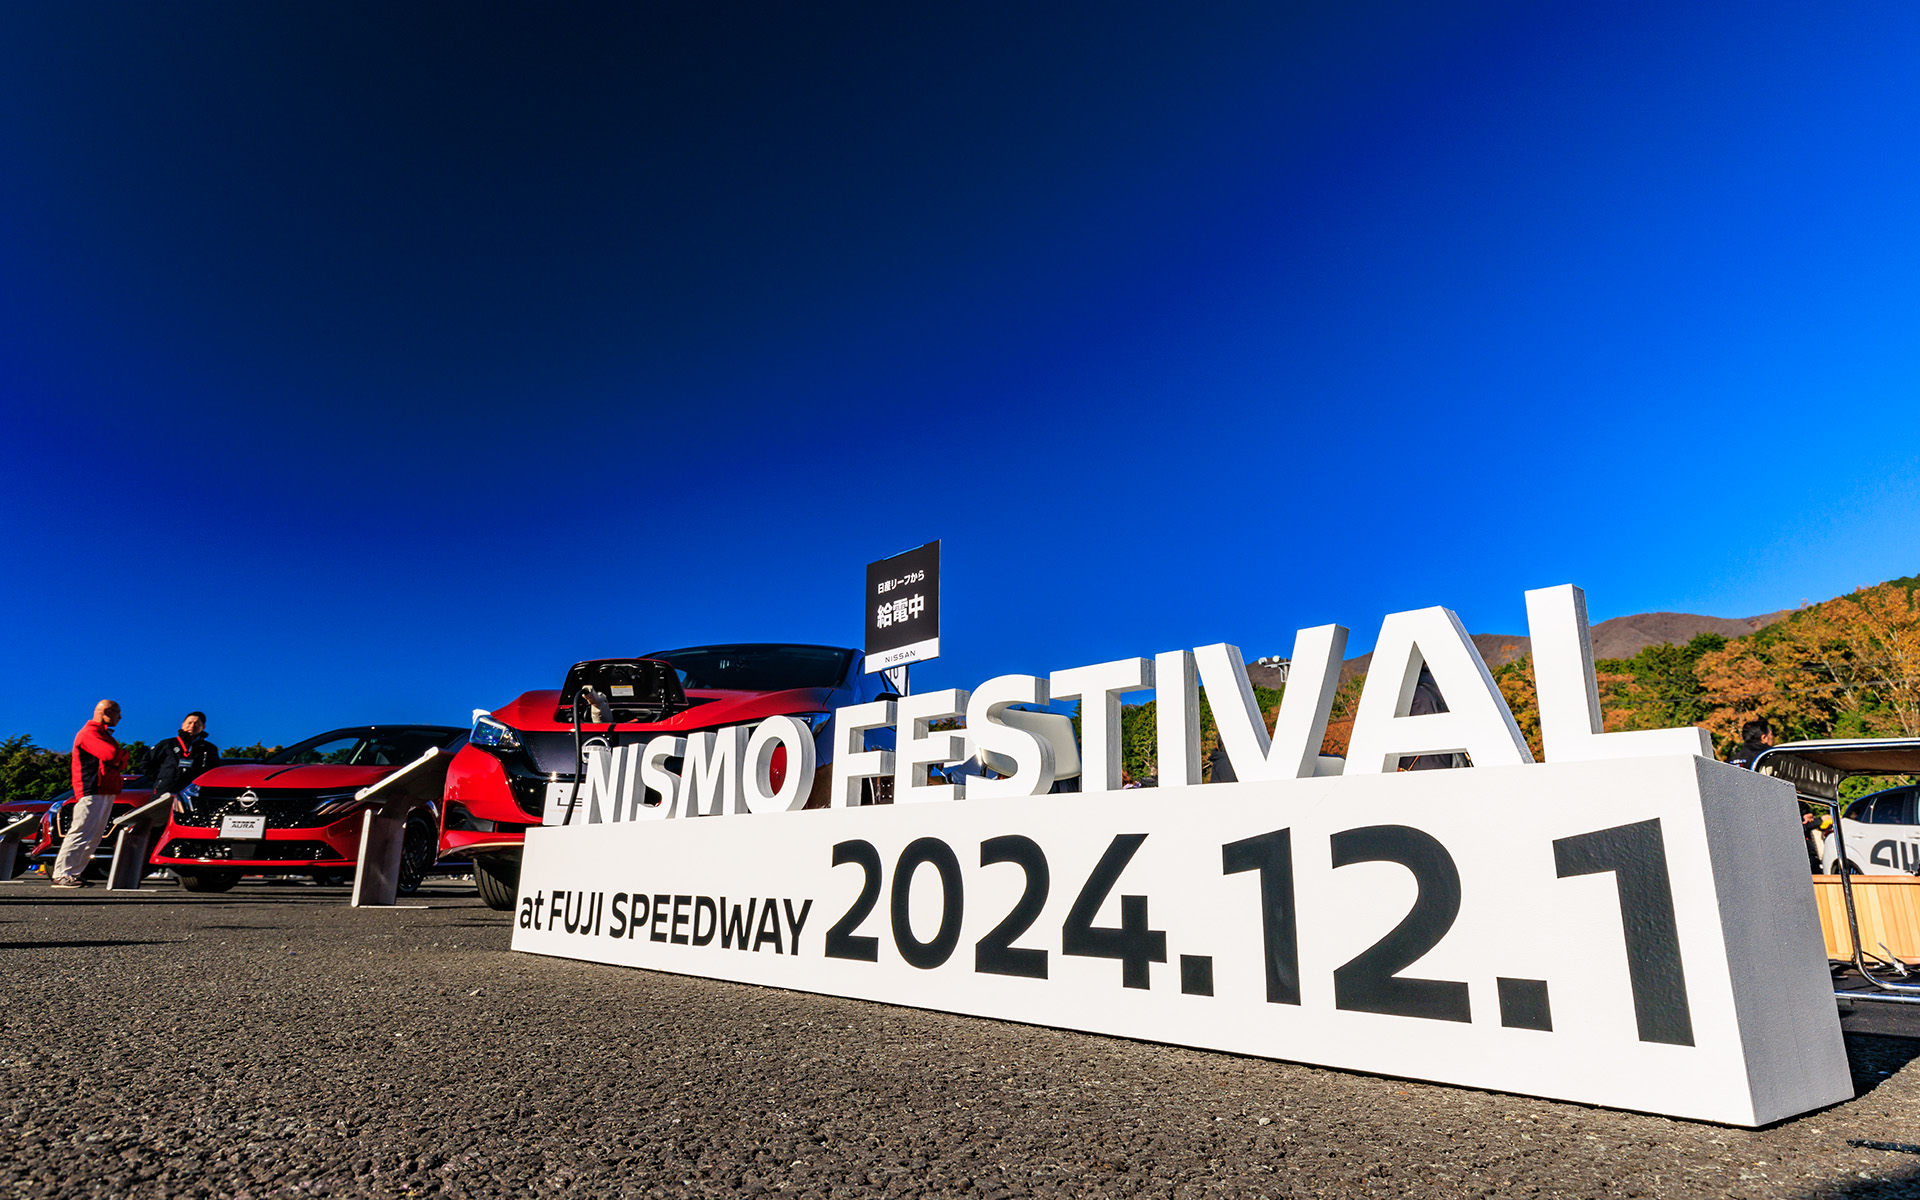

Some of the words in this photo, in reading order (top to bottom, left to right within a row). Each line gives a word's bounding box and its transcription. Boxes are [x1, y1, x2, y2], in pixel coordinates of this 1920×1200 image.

[877, 569, 925, 595] 日産リーフから
[876, 593, 925, 630] 給電中
[884, 649, 917, 663] NISSAN
[581, 715, 816, 826] NISMO
[830, 584, 1713, 808] FESTIVAL
[519, 891, 544, 931] at
[547, 890, 605, 936] FUJI
[609, 892, 814, 956] SPEEDWAY
[824, 817, 1695, 1048] 2024.12.1
